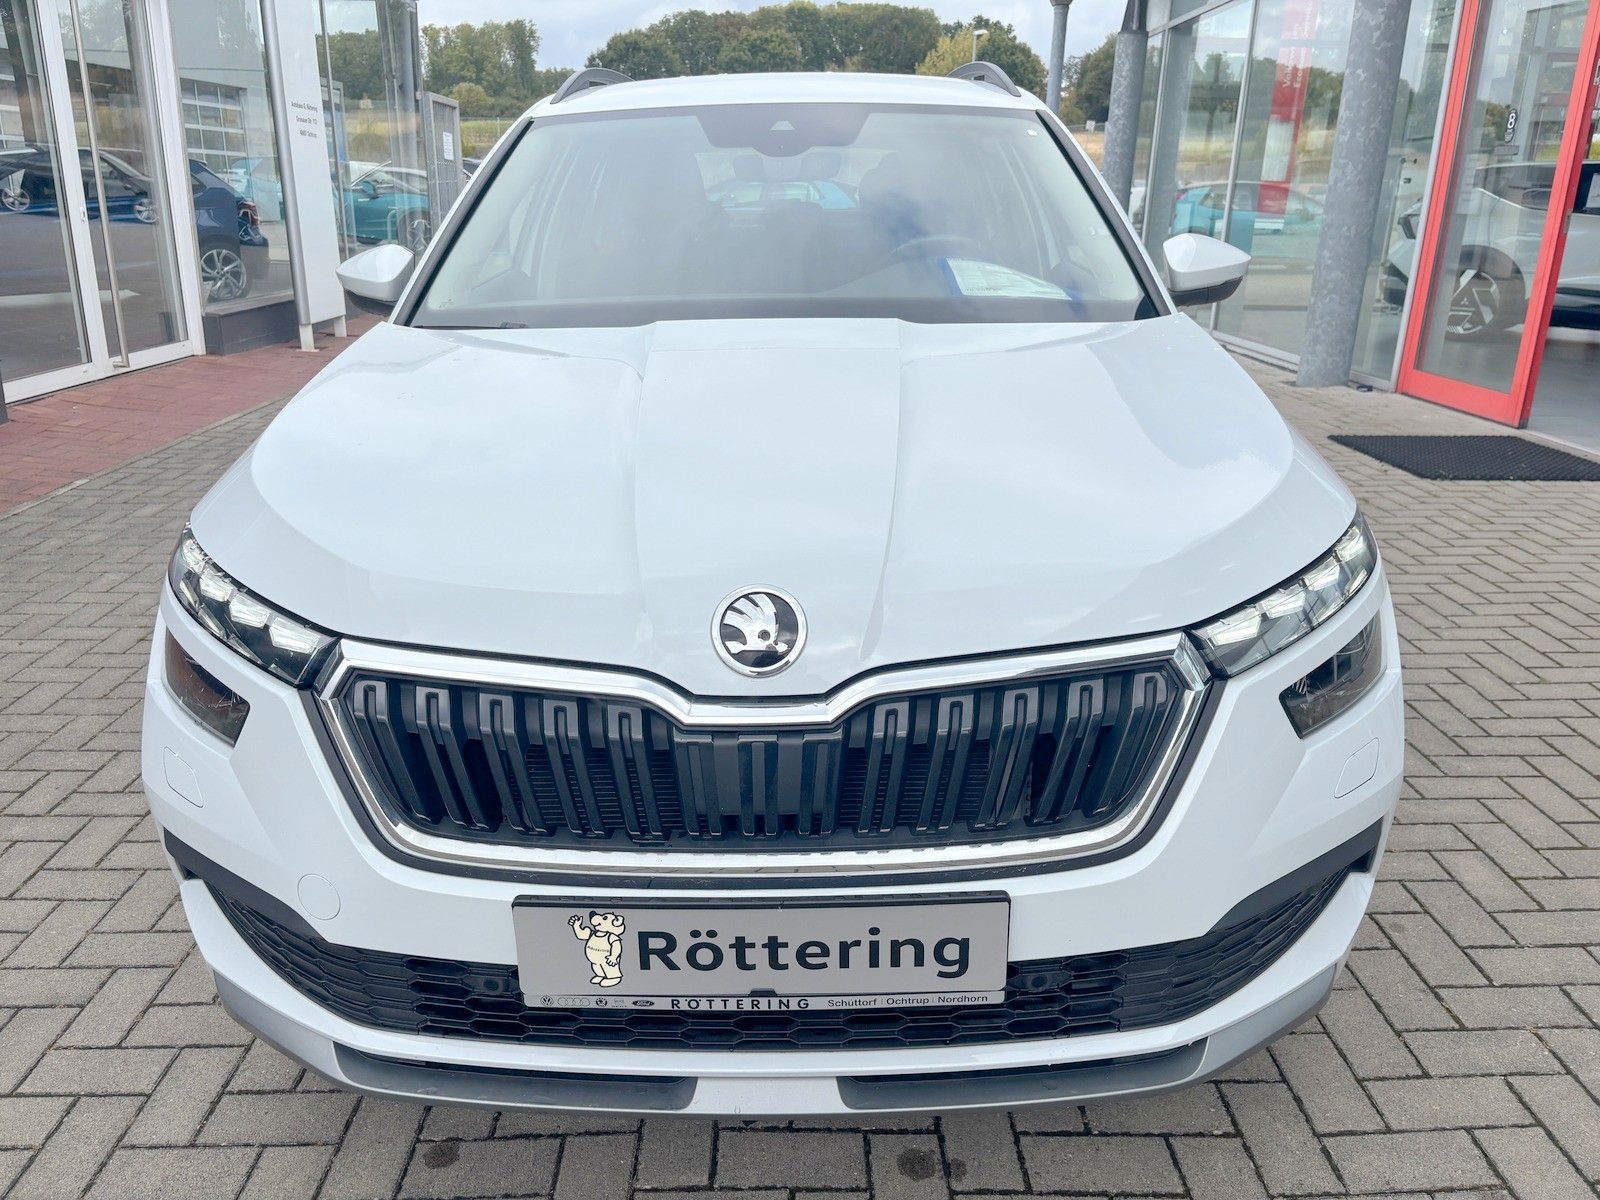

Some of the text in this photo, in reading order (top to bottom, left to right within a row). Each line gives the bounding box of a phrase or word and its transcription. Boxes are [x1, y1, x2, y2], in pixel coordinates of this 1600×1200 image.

[637, 926, 970, 979] Röttering
[671, 998, 809, 1010] RÖTTERING
[886, 996, 930, 1006] Ochtrup
[937, 995, 988, 1004] Nordhorn
